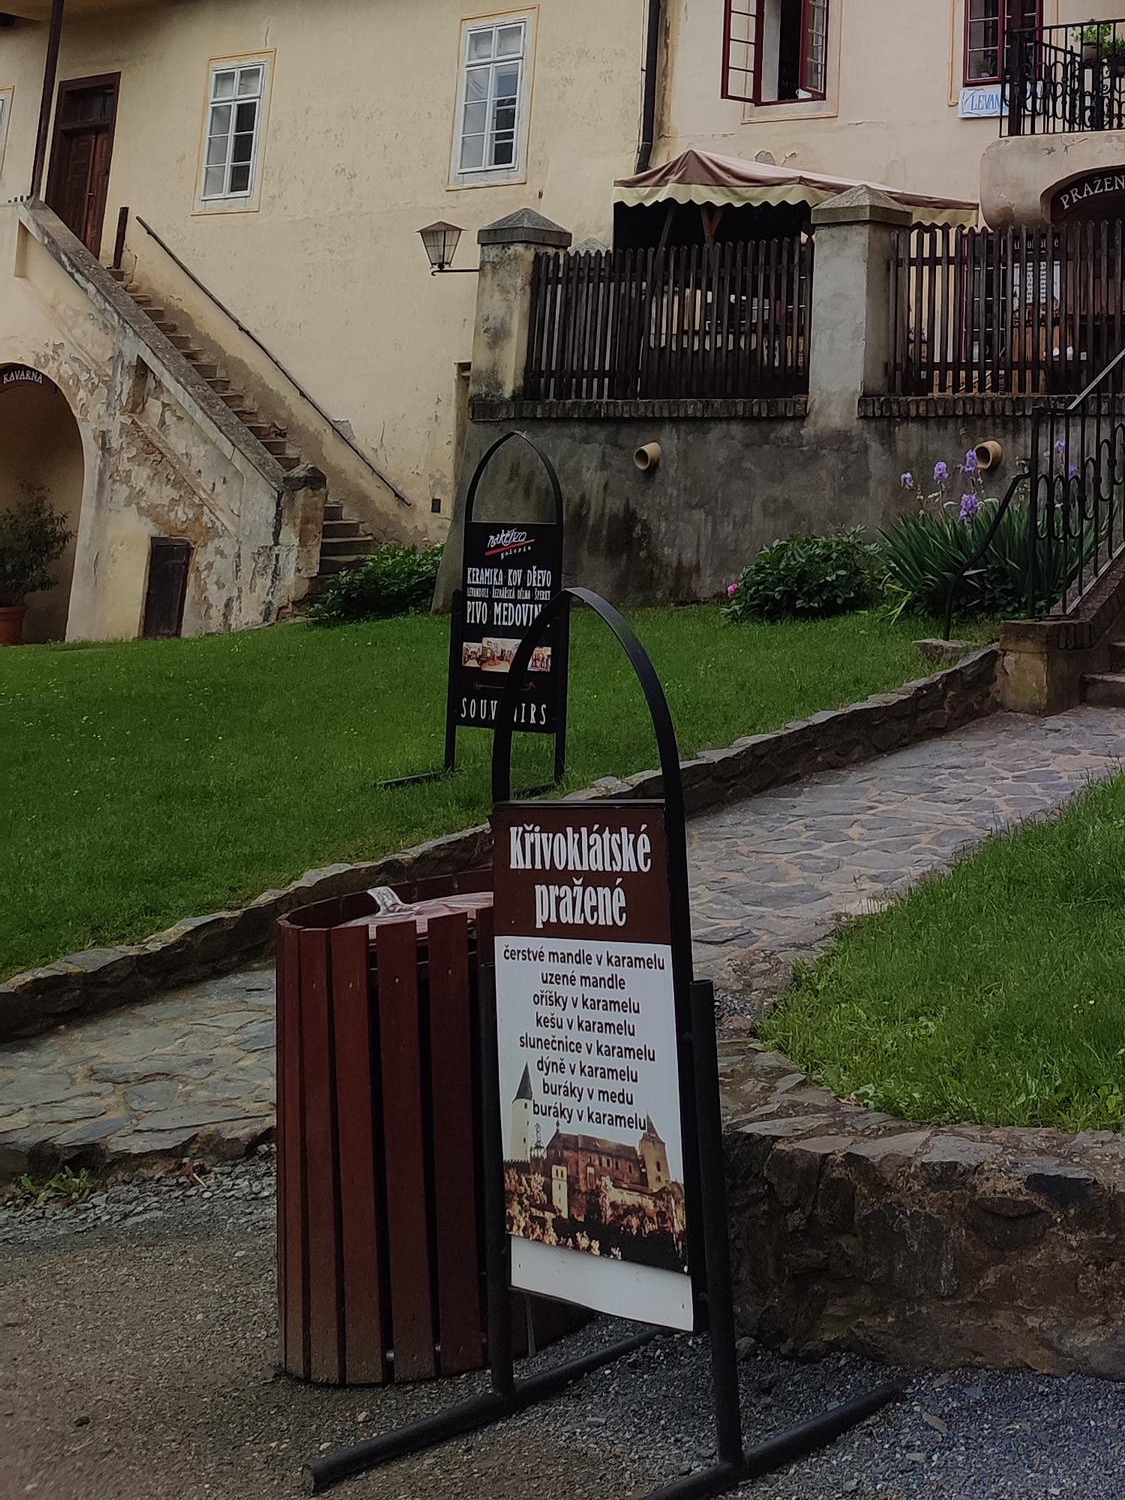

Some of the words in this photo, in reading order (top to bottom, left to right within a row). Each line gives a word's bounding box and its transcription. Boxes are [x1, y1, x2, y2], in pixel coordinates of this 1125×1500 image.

[467, 567, 503, 586] KERAMIKA
[508, 568, 522, 586] KOV
[527, 566, 551, 587] DŘEVO
[467, 601, 488, 624] PIVO
[494, 602, 550, 627] MEDOVIN
[461, 697, 546, 725] SOUVIRS
[510, 823, 652, 872] Křivoklátské
[535, 877, 626, 928] pražené
[503, 944, 544, 962] čerstvé
[549, 949, 592, 966] mandle
[595, 956, 603, 966] v
[607, 951, 665, 970] karamelu
[541, 970, 576, 987] uzené
[580, 973, 626, 990] mandle
[533, 989, 568, 1011] oříšky
[571, 998, 578, 1009] v
[582, 993, 640, 1014] karamelu
[536, 1011, 563, 1029] kešu
[567, 1019, 574, 1030] v
[577, 1015, 635, 1036] karamelu
[519, 1032, 582, 1053] slunečnice
[586, 1043, 593, 1055] v
[596, 1040, 655, 1062] karamelu
[537, 1056, 566, 1076] dýně
[569, 1063, 576, 1075] v
[580, 1060, 638, 1083] karamelu
[542, 1078, 583, 1103] buráky
[587, 1088, 594, 1100] v
[598, 1088, 634, 1105] medu
[533, 1099, 573, 1124] buráky
[577, 1110, 584, 1121] v
[587, 1106, 647, 1131] karamelu
